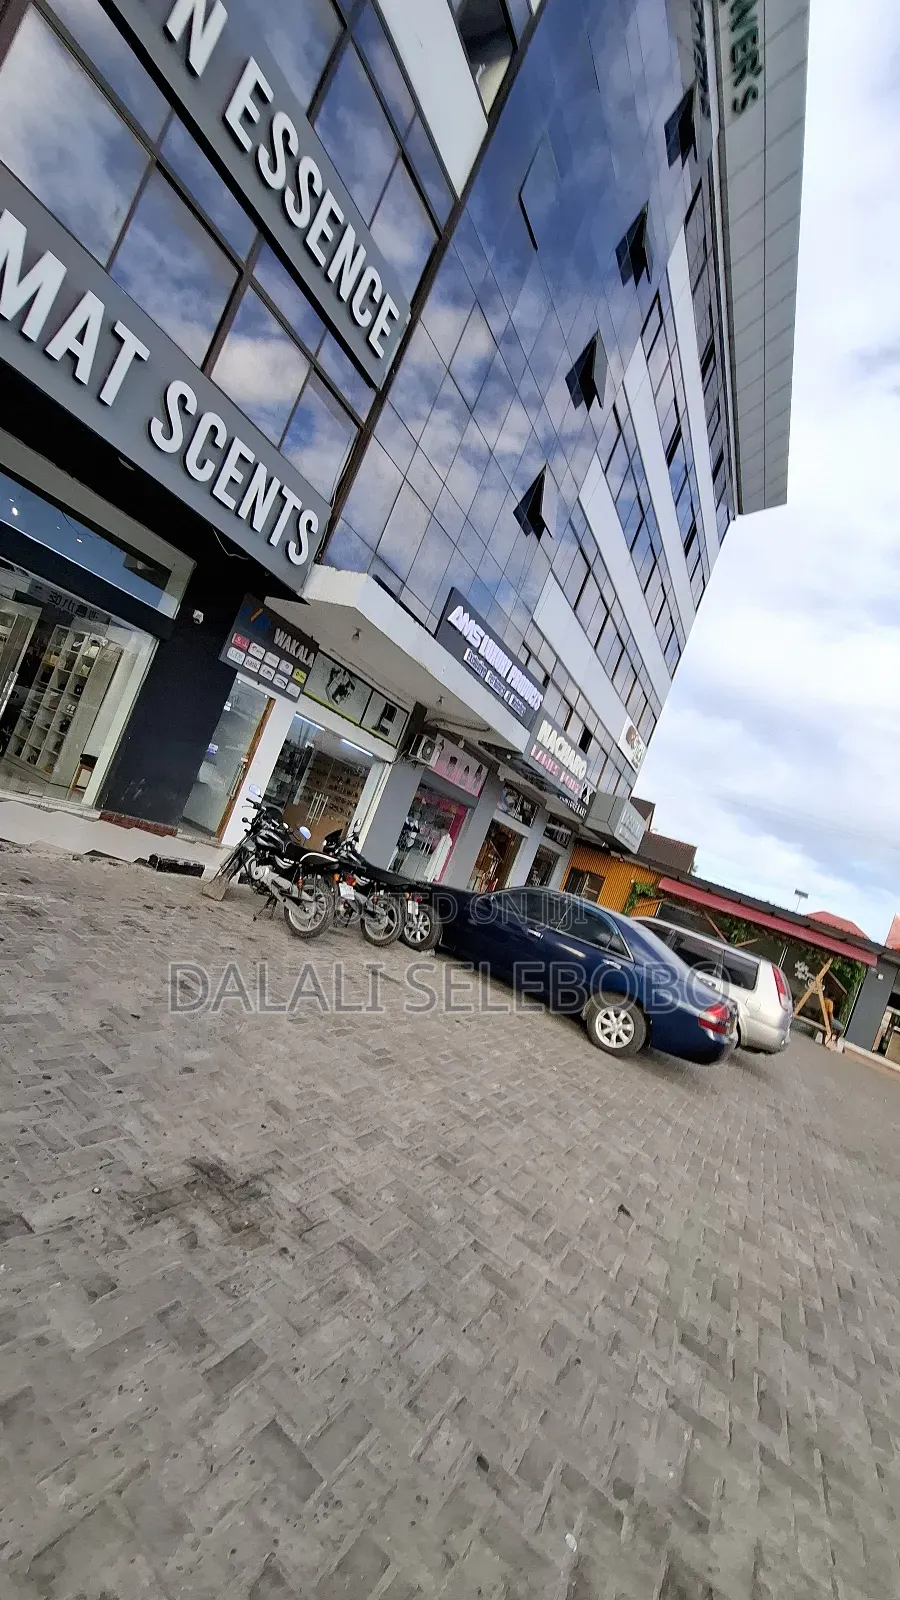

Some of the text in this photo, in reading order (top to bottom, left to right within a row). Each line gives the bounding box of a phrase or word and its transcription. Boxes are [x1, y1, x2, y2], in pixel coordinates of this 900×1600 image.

[165, 0, 400, 358] N ESSENCE
[0, 208, 320, 567] MAT SCENTS
[273, 627, 315, 668] WAKALA
